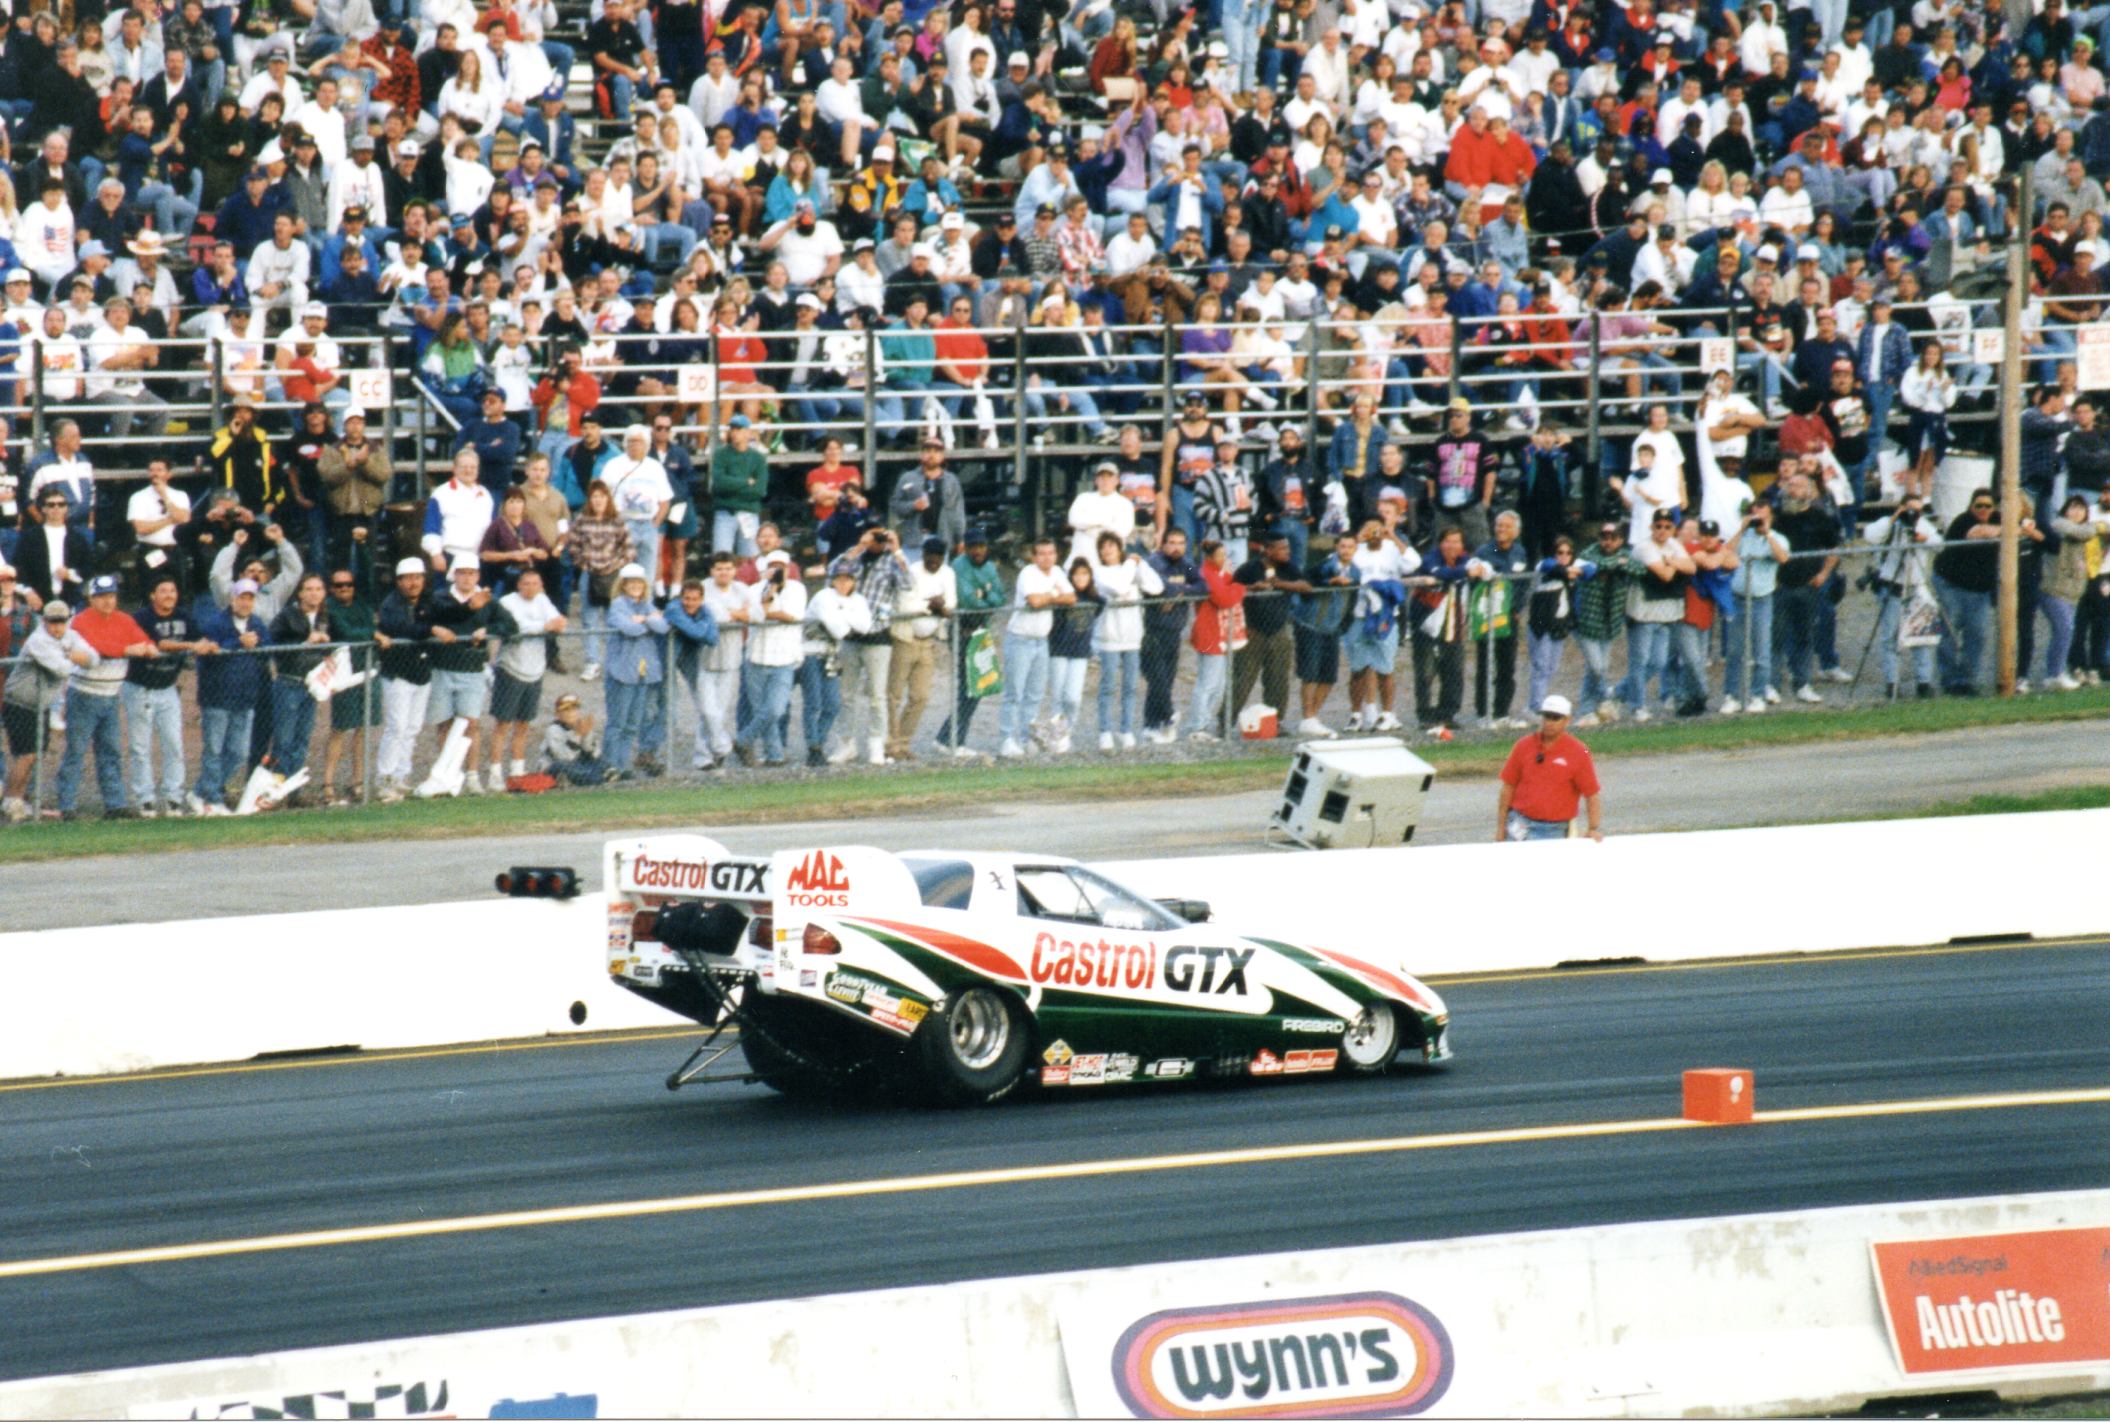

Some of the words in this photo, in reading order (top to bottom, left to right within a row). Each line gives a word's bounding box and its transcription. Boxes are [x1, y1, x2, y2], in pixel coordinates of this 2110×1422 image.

[360, 380, 383, 397] CC
[633, 855, 707, 889] Castrol
[711, 862, 768, 893] GTX
[787, 850, 849, 890] MAC
[787, 895, 848, 907] TOOLS
[1031, 932, 1156, 989] Castrol
[1164, 945, 1256, 996] GTX
[1282, 1020, 1345, 1033] FIREBIRD
[1915, 1290, 2065, 1350] Autolite
